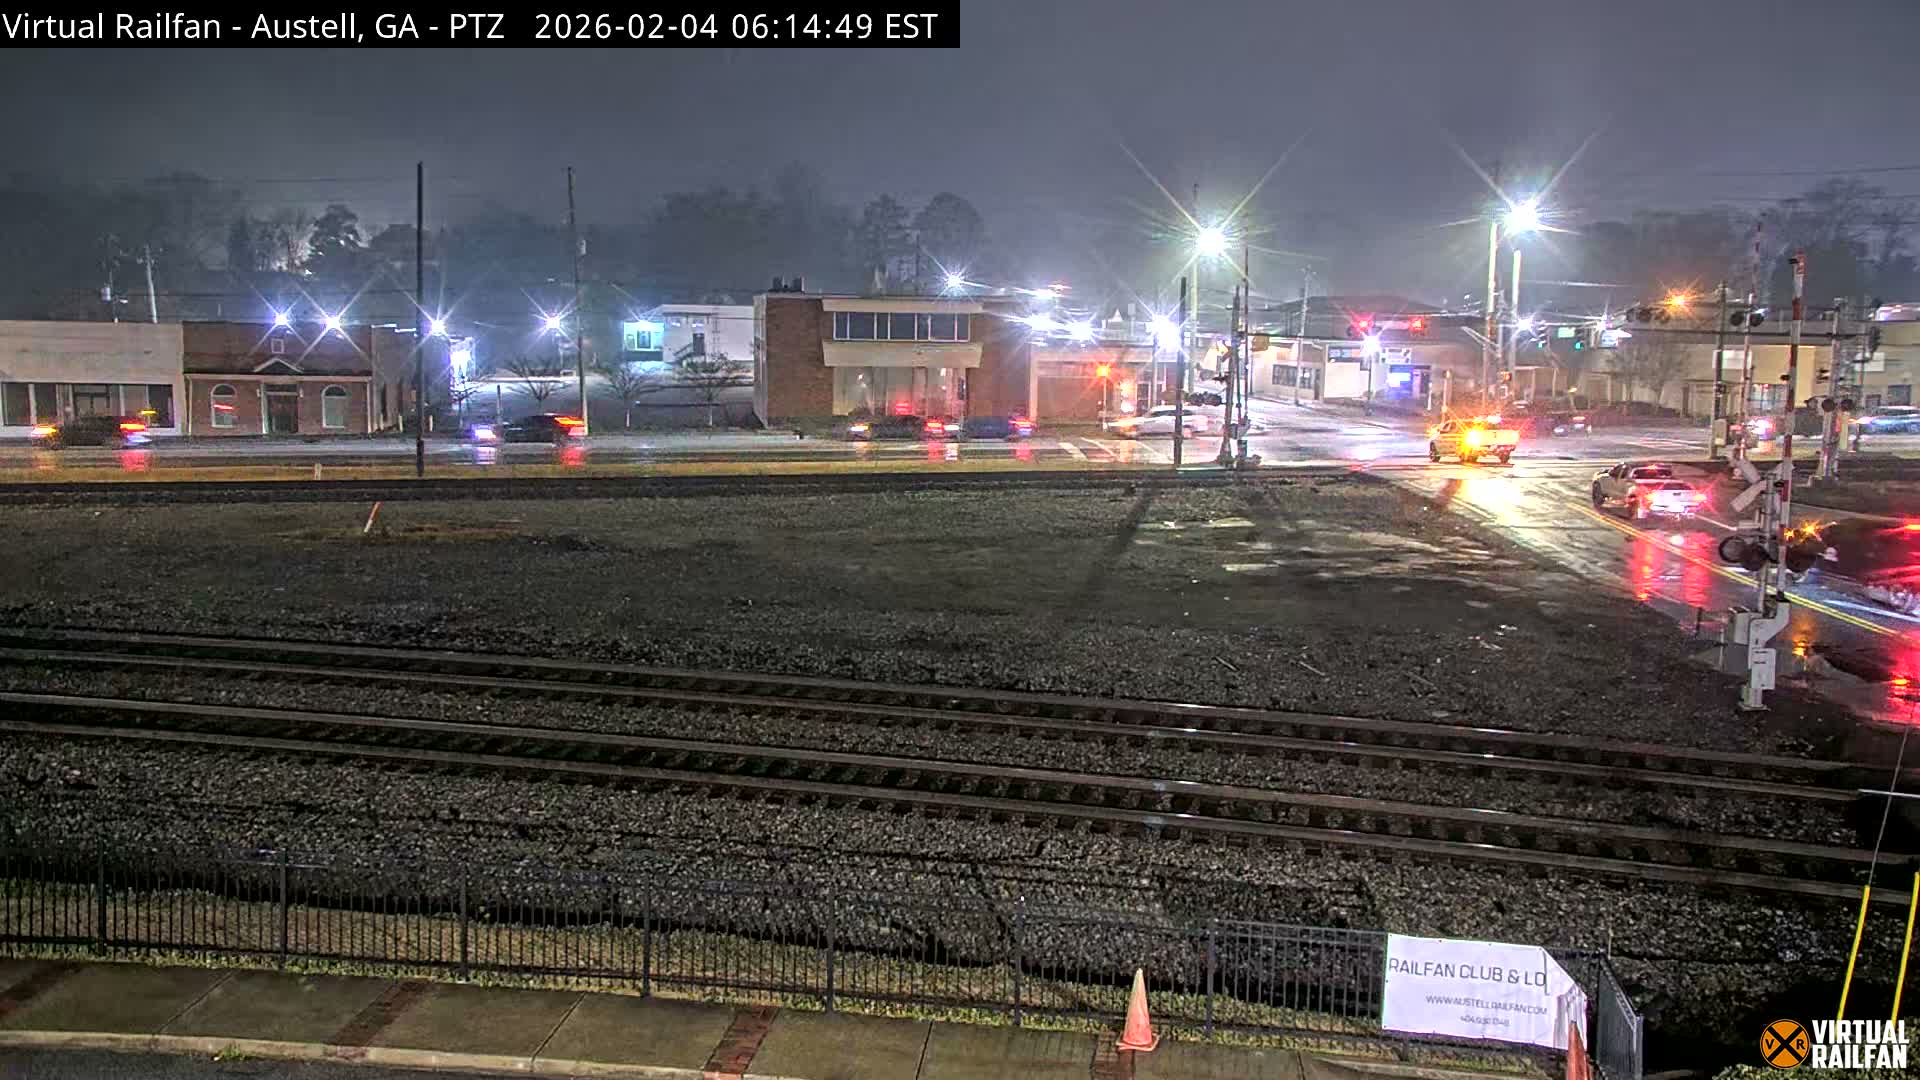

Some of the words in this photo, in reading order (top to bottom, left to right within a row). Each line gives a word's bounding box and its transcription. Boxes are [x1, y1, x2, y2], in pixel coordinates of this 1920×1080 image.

[1389, 957, 1455, 979] RAILFAN
[1460, 963, 1502, 982] CLUB
[1507, 968, 1520, 985] &
